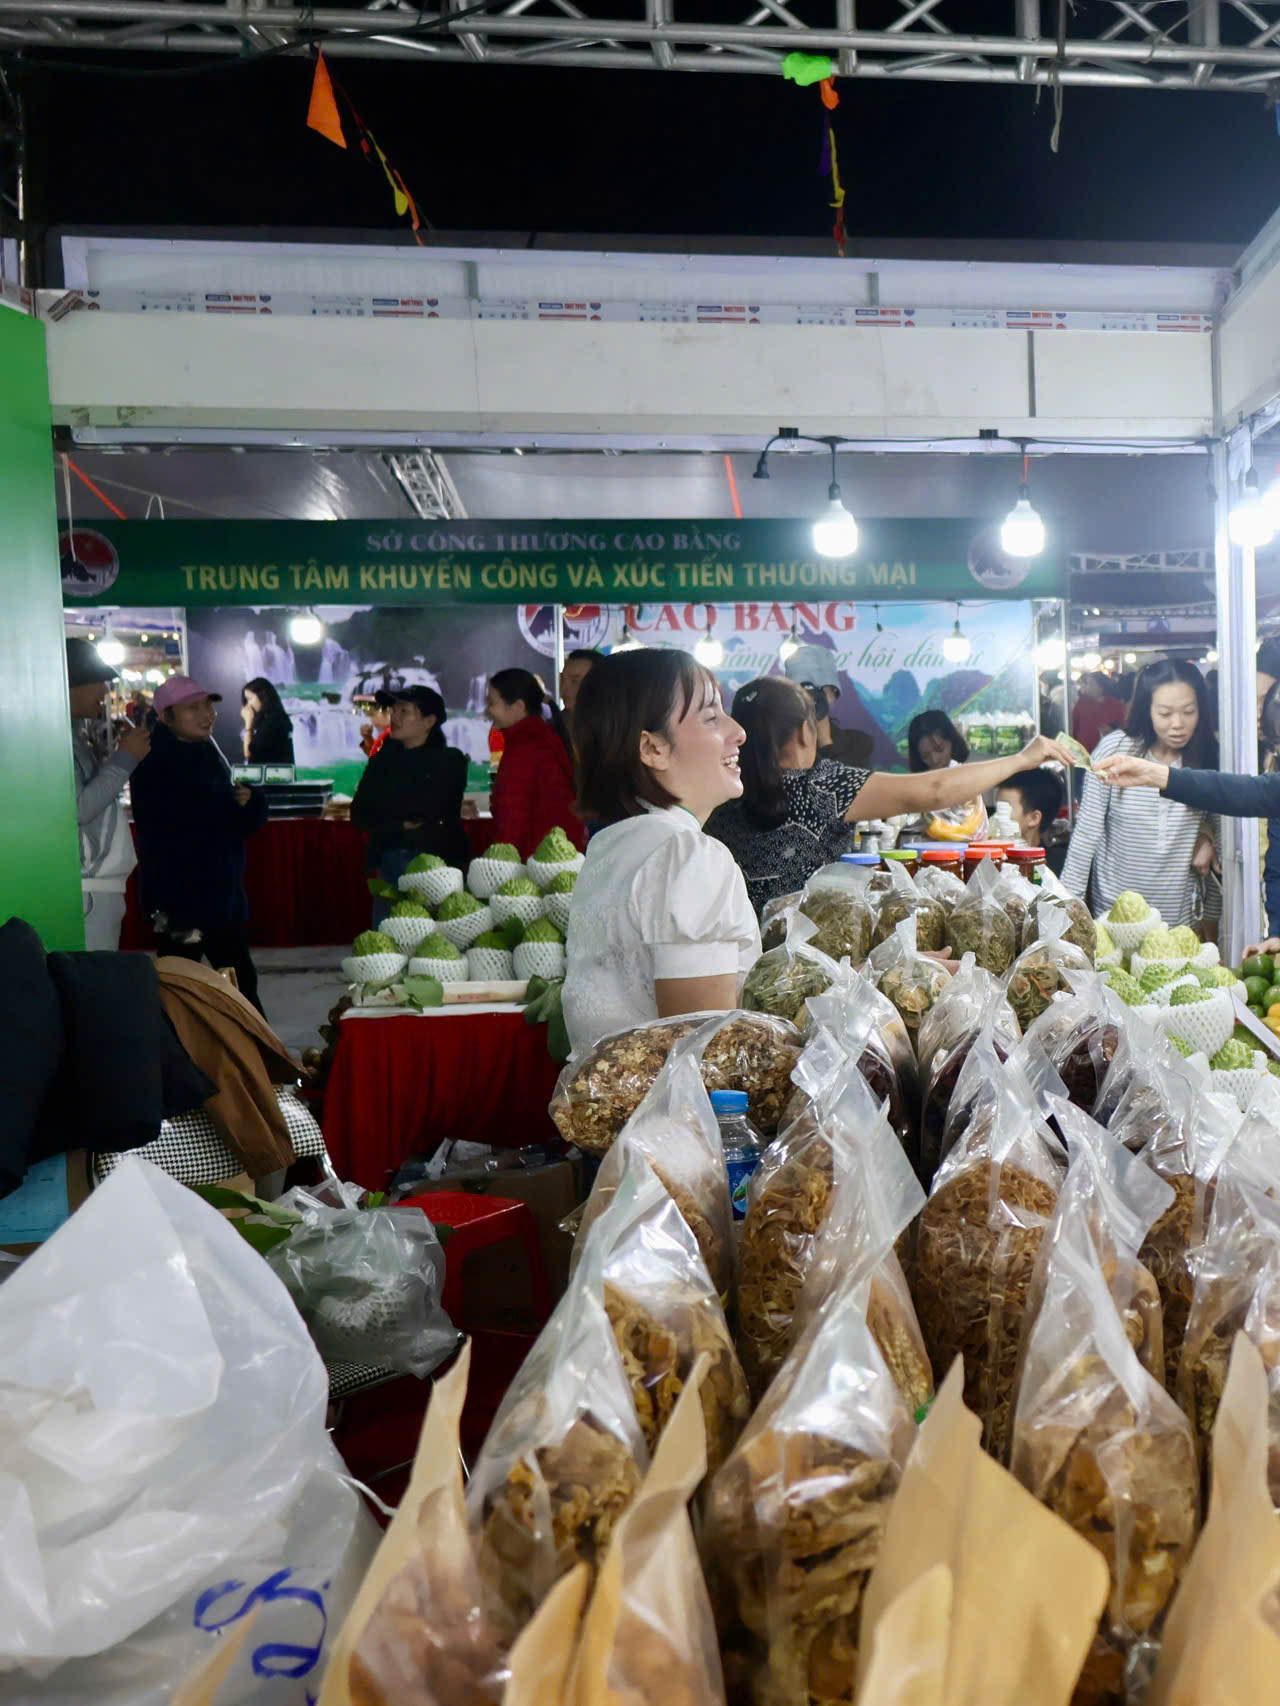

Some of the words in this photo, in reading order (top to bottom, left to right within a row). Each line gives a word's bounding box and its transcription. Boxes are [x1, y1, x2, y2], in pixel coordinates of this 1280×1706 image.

[410, 528, 485, 552] CÔNG
[613, 532, 666, 551] CAO
[180, 564, 280, 591] TRUNG
[288, 558, 350, 590] TÂM
[359, 553, 472, 590] KHUYẾN
[481, 559, 558, 590] CÔNG
[566, 557, 605, 588] VÀ
[612, 556, 666, 588] XÚC
[675, 553, 735, 588] TIẾN
[624, 602, 718, 632] CAO
